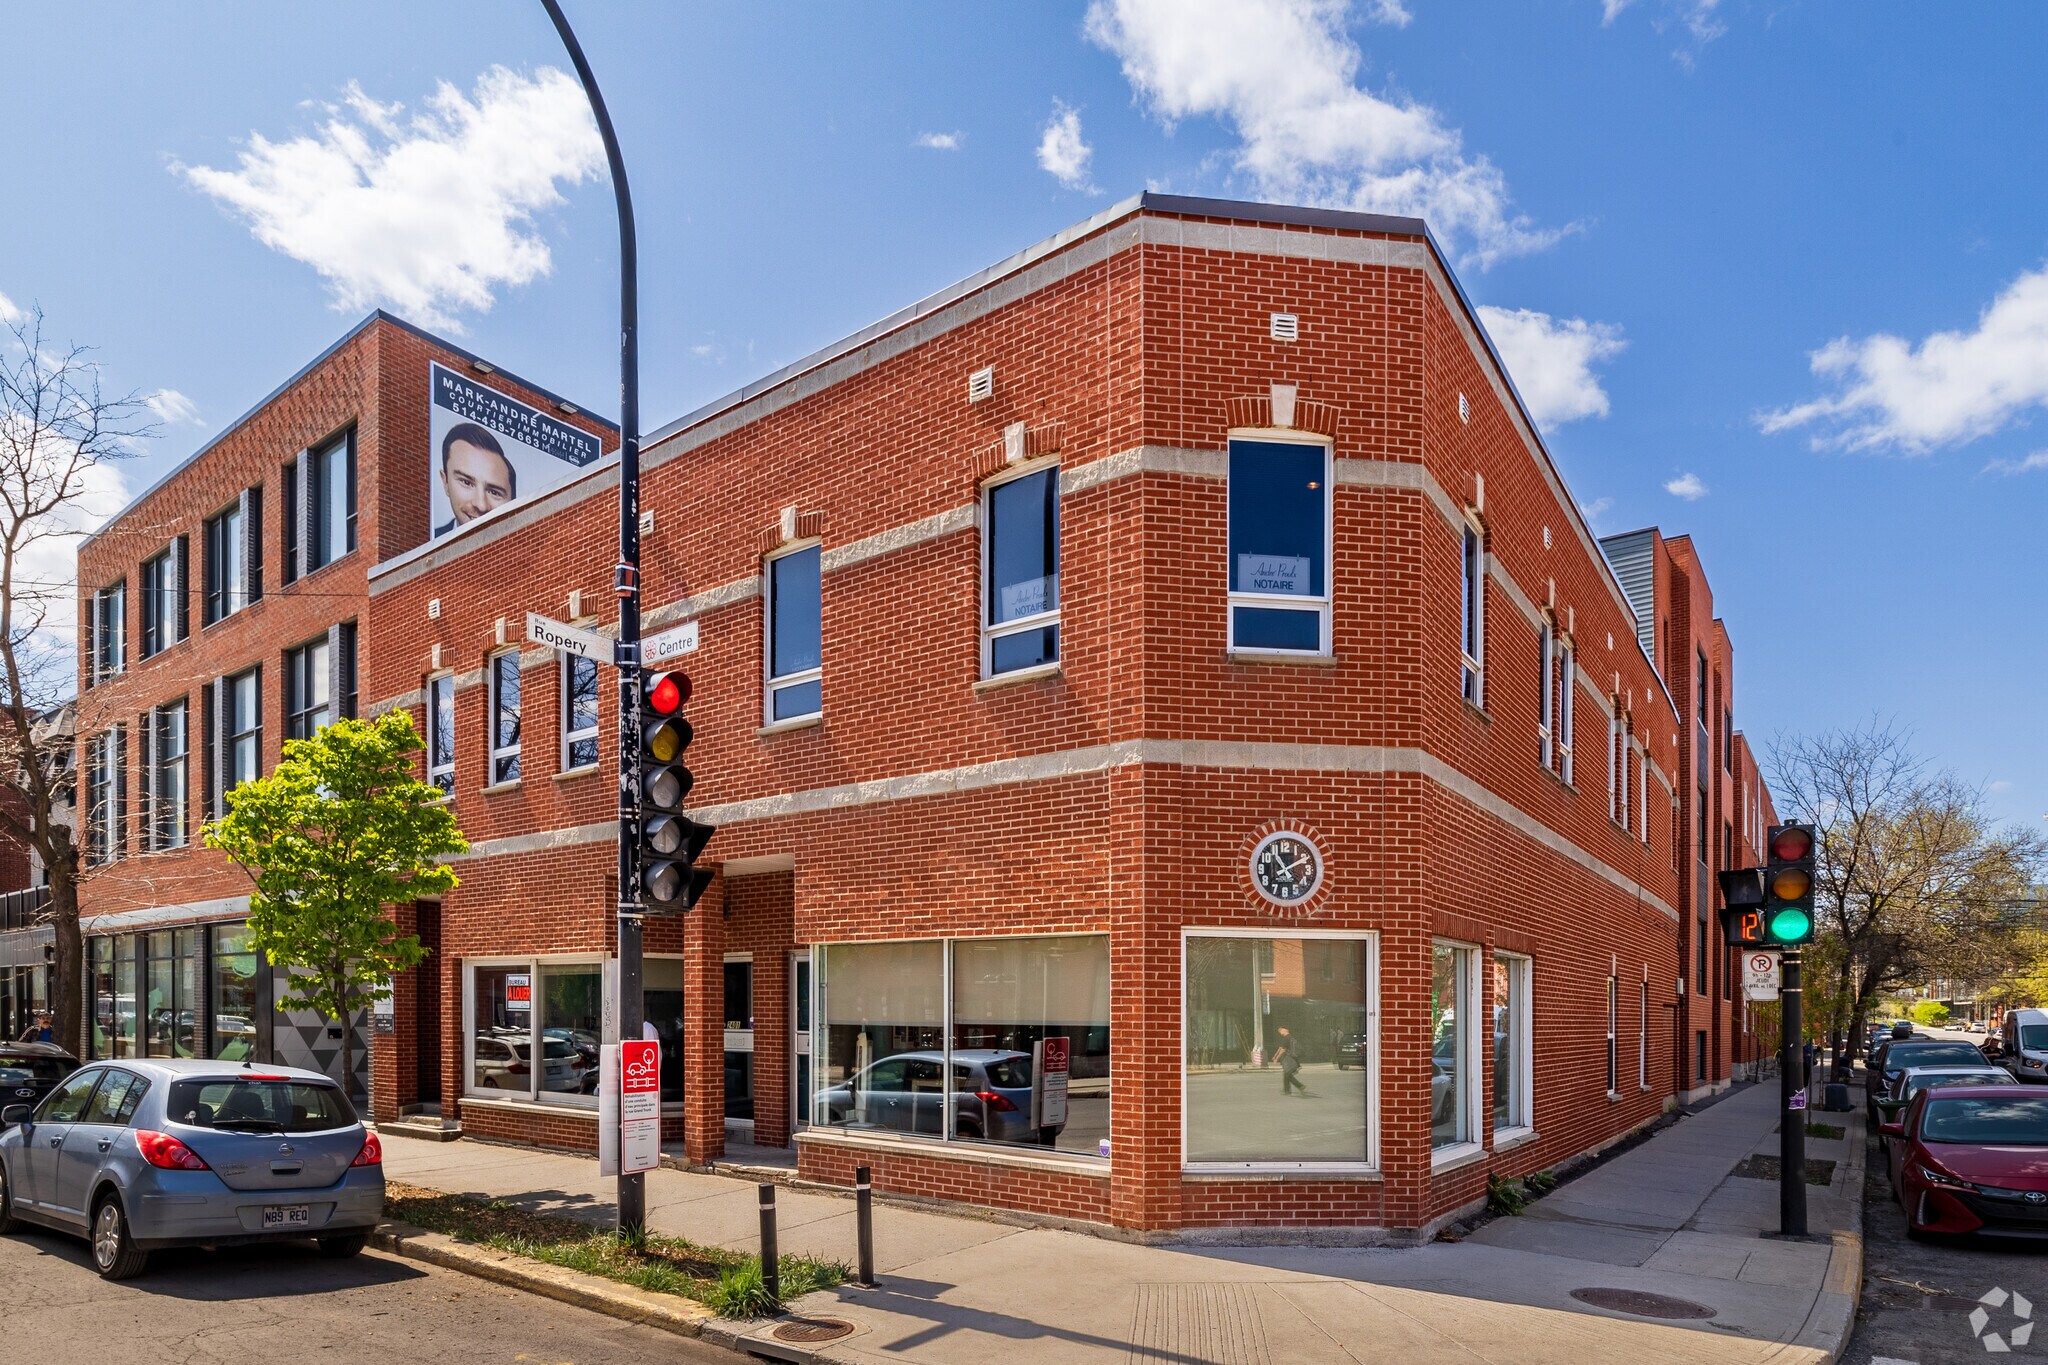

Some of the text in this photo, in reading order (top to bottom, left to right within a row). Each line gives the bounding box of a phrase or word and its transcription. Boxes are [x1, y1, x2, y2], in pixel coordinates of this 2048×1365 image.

[443, 376, 592, 453] MARK-ANDRÉ MARTEL
[449, 392, 513, 425] COURTIER
[517, 423, 588, 459] IMMOBILIER
[452, 402, 540, 448] 514-439-7663
[1253, 579, 1294, 590] NOTAIRE
[1014, 600, 1048, 616] NOTAIRE
[534, 618, 546, 626] Rue
[534, 625, 587, 655] Ropery
[659, 637, 693, 655] Centre
[1271, 844, 1278, 855] 11
[1280, 842, 1290, 853] 12
[1294, 845, 1298, 856] 1
[1261, 853, 1271, 863] 10
[1258, 864, 1264, 874] 9
[1305, 865, 1311, 875] 3
[1262, 875, 1269, 886] 8
[1300, 876, 1307, 886] 4
[1271, 884, 1278, 894] 7
[1281, 887, 1288, 897] 6
[1292, 884, 1299, 895] 5
[1741, 913, 1758, 940] 12
[513, 986, 530, 1001] LOUER
[265, 1209, 308, 1223] N89 REQ
